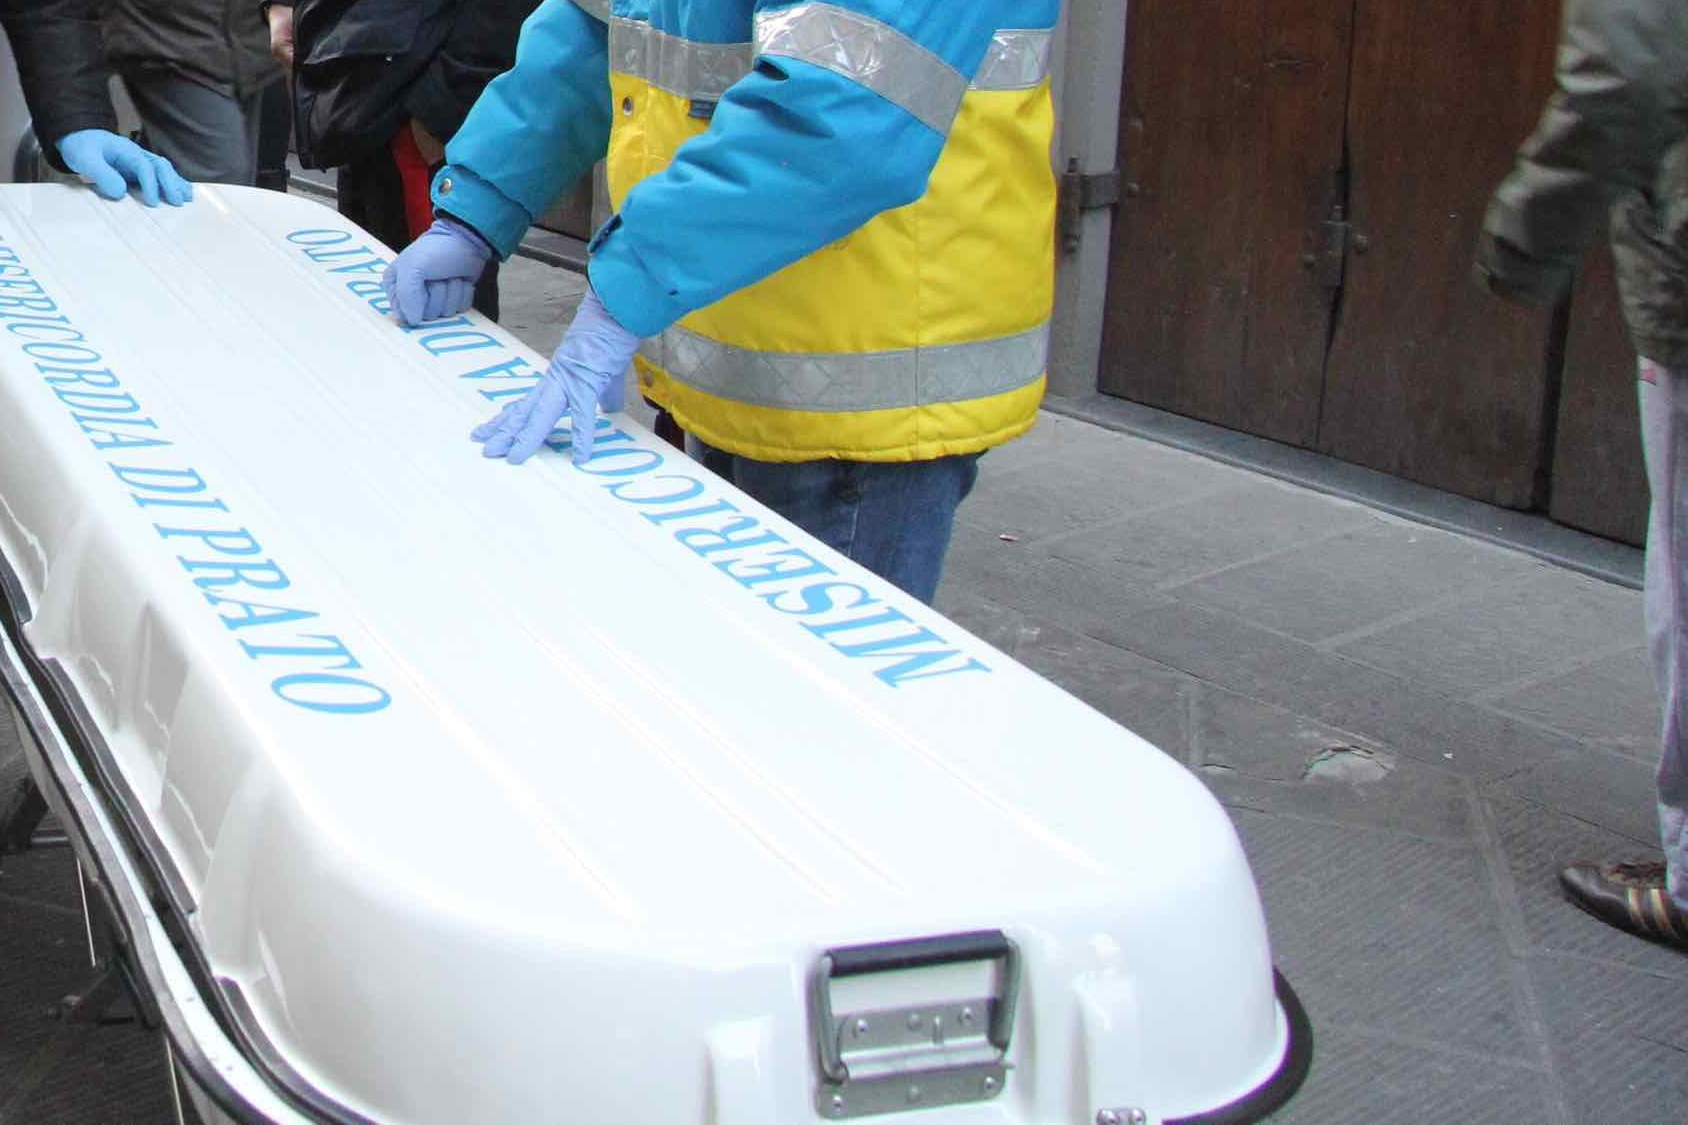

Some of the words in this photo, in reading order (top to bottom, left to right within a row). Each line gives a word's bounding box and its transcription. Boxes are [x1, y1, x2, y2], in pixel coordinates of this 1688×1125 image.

[107, 462, 231, 514] DI
[459, 357, 992, 690] MISERICORIA
[152, 523, 393, 716] PRATO
